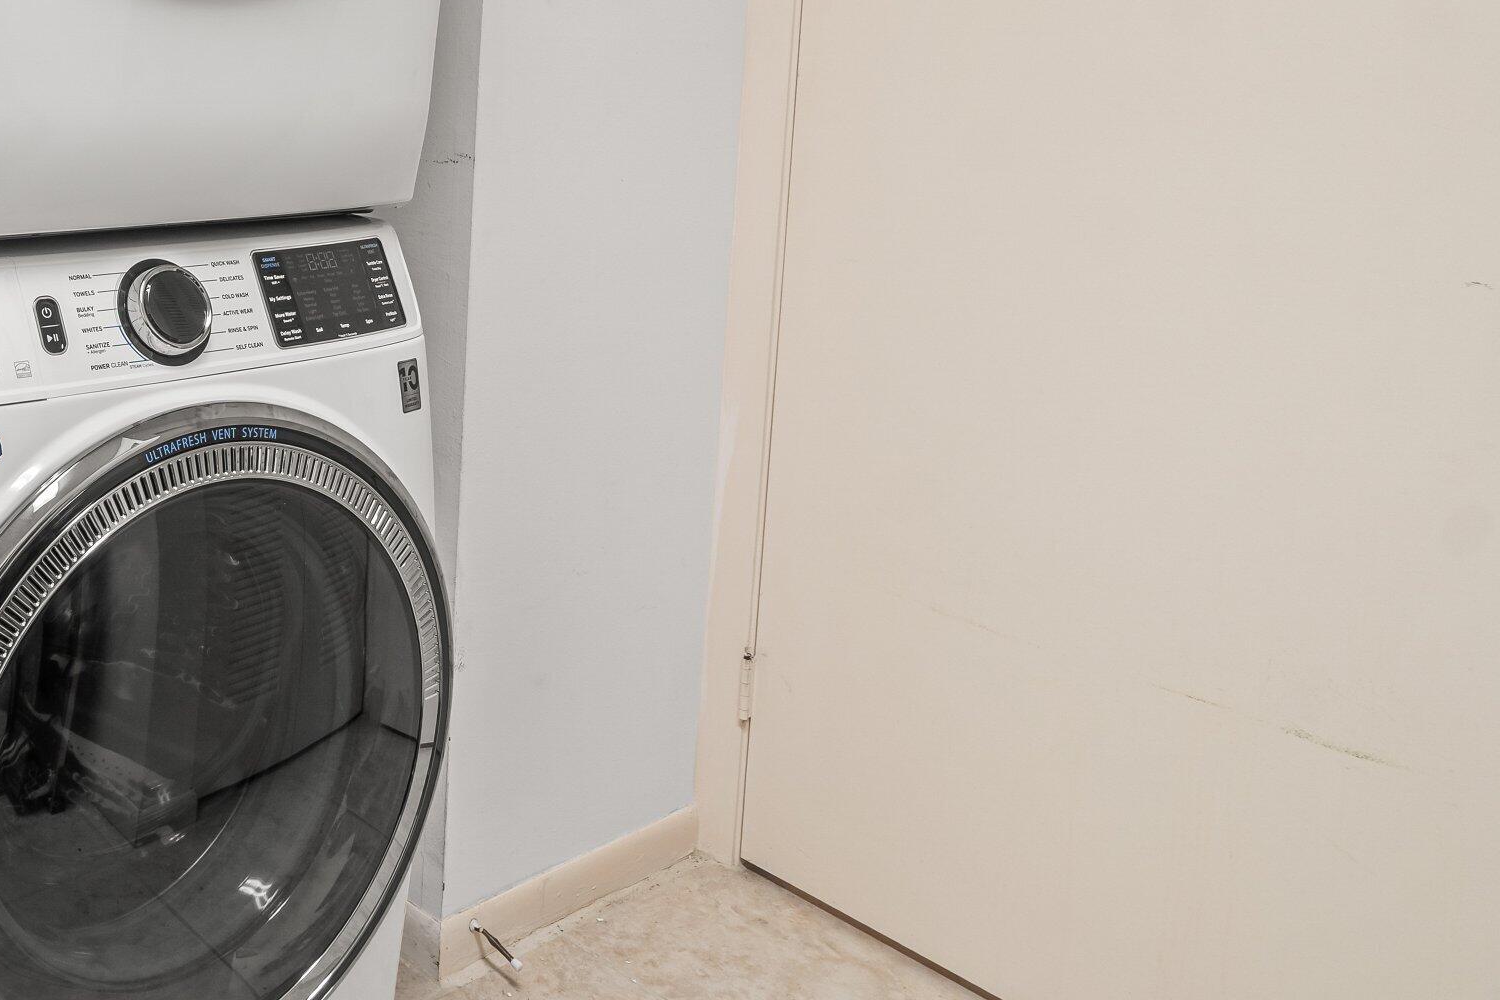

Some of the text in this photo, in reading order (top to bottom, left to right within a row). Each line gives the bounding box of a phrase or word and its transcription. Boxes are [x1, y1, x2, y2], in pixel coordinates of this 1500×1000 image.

[86, 342, 110, 350] SANITIZE
[90, 363, 110, 371] POWER
[145, 427, 277, 463] ULTRAFRESH VENT SYSTEM
